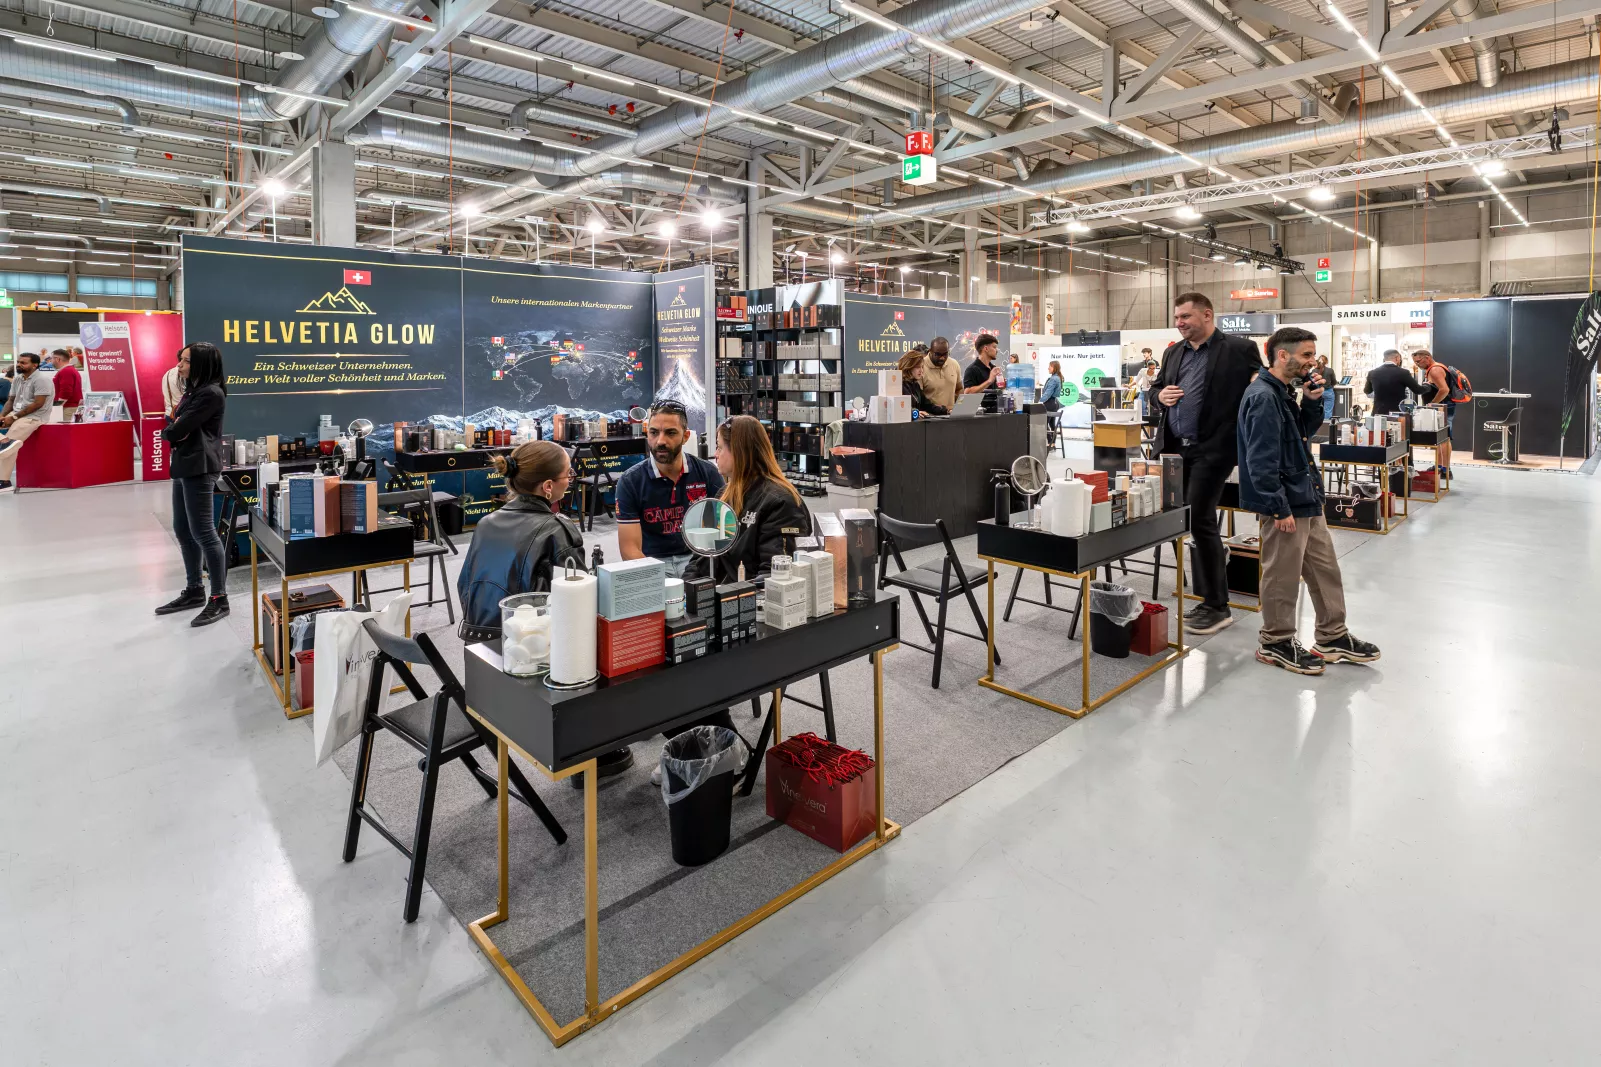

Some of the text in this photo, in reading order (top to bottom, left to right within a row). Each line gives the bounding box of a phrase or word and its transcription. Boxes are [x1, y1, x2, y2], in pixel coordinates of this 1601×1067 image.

[908, 135, 915, 151] F
[922, 134, 928, 148] F
[490, 296, 633, 310] Unsere internationalen Markenpartner
[656, 308, 700, 320] HELVETIA GLOW
[1337, 310, 1386, 318] SAMSUNG
[224, 320, 435, 344] HELVETIA GLOW
[858, 340, 900, 352] HELVETIA
[253, 362, 413, 371] Ein Schweizer Unternehmen.
[226, 375, 260, 384] Einer
[264, 374, 290, 384] Welt
[293, 374, 325, 384] voller
[328, 373, 382, 383] Schönheit
[406, 372, 447, 381] Marken.
[1084, 376, 1096, 385] 24
[152, 429, 163, 471] Helsana
[644, 506, 684, 524] CAMP
